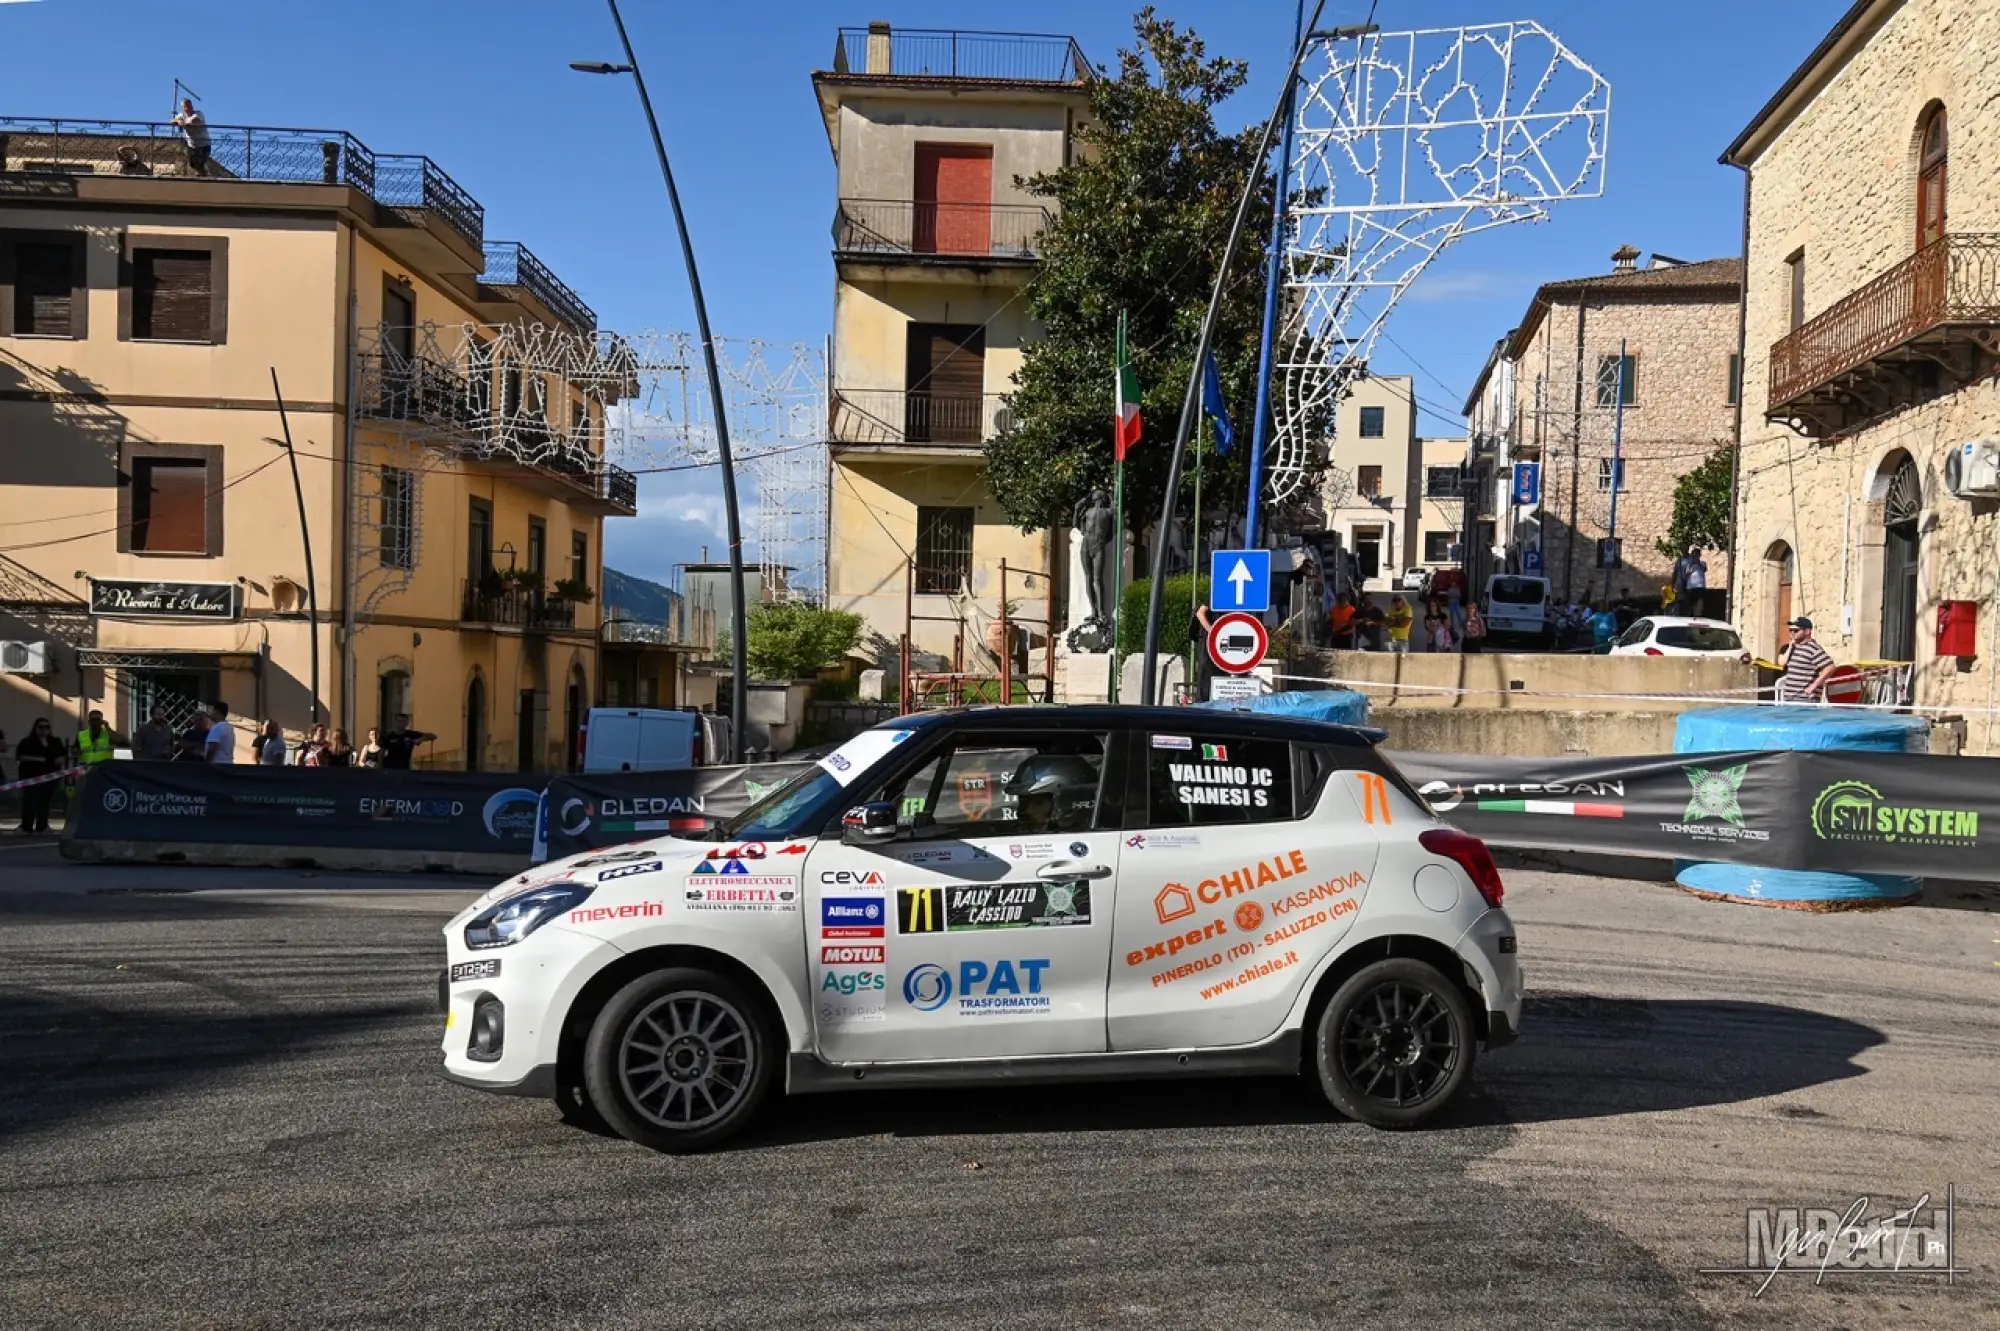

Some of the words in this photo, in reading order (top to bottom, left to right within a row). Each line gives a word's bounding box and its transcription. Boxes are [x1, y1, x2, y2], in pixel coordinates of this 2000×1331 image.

[1527, 553, 1538, 567] P
[108, 588, 162, 608] Ricordi
[964, 779, 985, 789] STR
[1169, 764, 1247, 784] VALLINO
[1251, 768, 1272, 786] JC
[601, 796, 705, 816] CLEDAN
[1179, 787, 1250, 806] SANESI
[1254, 789, 1268, 807] S
[1356, 772, 1392, 825] 71
[1660, 822, 1718, 836] TECHNICAL
[1719, 827, 1769, 840] SERVICES
[1877, 807, 1978, 837] SYSTEM
[1831, 833, 1880, 842] FACILITY
[1900, 837, 1977, 847] MANAGEMENT
[1197, 849, 1308, 904] CHIALE
[706, 890, 776, 901] ERBETTA
[953, 891, 993, 908] RALLY
[998, 888, 1036, 904] LAZIO
[1271, 870, 1366, 916] KASANOVA
[571, 901, 663, 924] meverin
[828, 906, 864, 916] Allianz
[906, 889, 933, 931] 71
[969, 906, 1022, 924] CASSINO
[1126, 918, 1228, 966] expert
[1151, 953, 1223, 988] PINEROLO
[1227, 941, 1256, 963] (TO)
[1263, 910, 1327, 946] SALUZZO
[1330, 898, 1359, 921] (CN)
[825, 948, 882, 962] MOTUL
[822, 971, 885, 995] Agos
[960, 959, 1050, 996] PAT
[1200, 950, 1299, 1000] www.chiale.it
[960, 997, 1050, 1008] TRASFORMATORI
